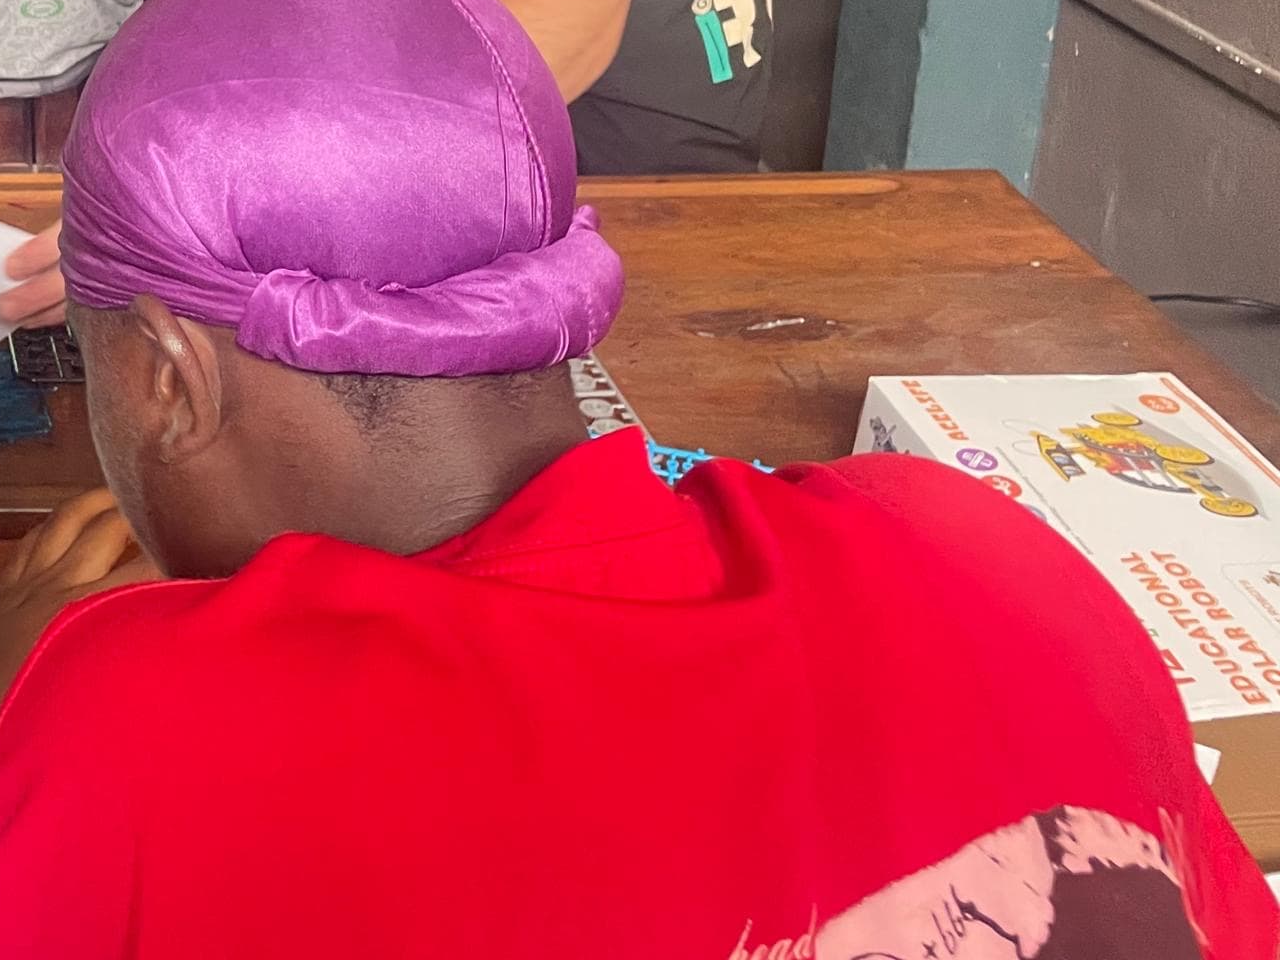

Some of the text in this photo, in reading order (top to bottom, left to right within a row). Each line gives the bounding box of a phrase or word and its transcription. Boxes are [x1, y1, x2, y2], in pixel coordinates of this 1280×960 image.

[1120, 551, 1272, 706] EDUCATIONAL
[1150, 550, 1280, 697] OLAR ROBOT
